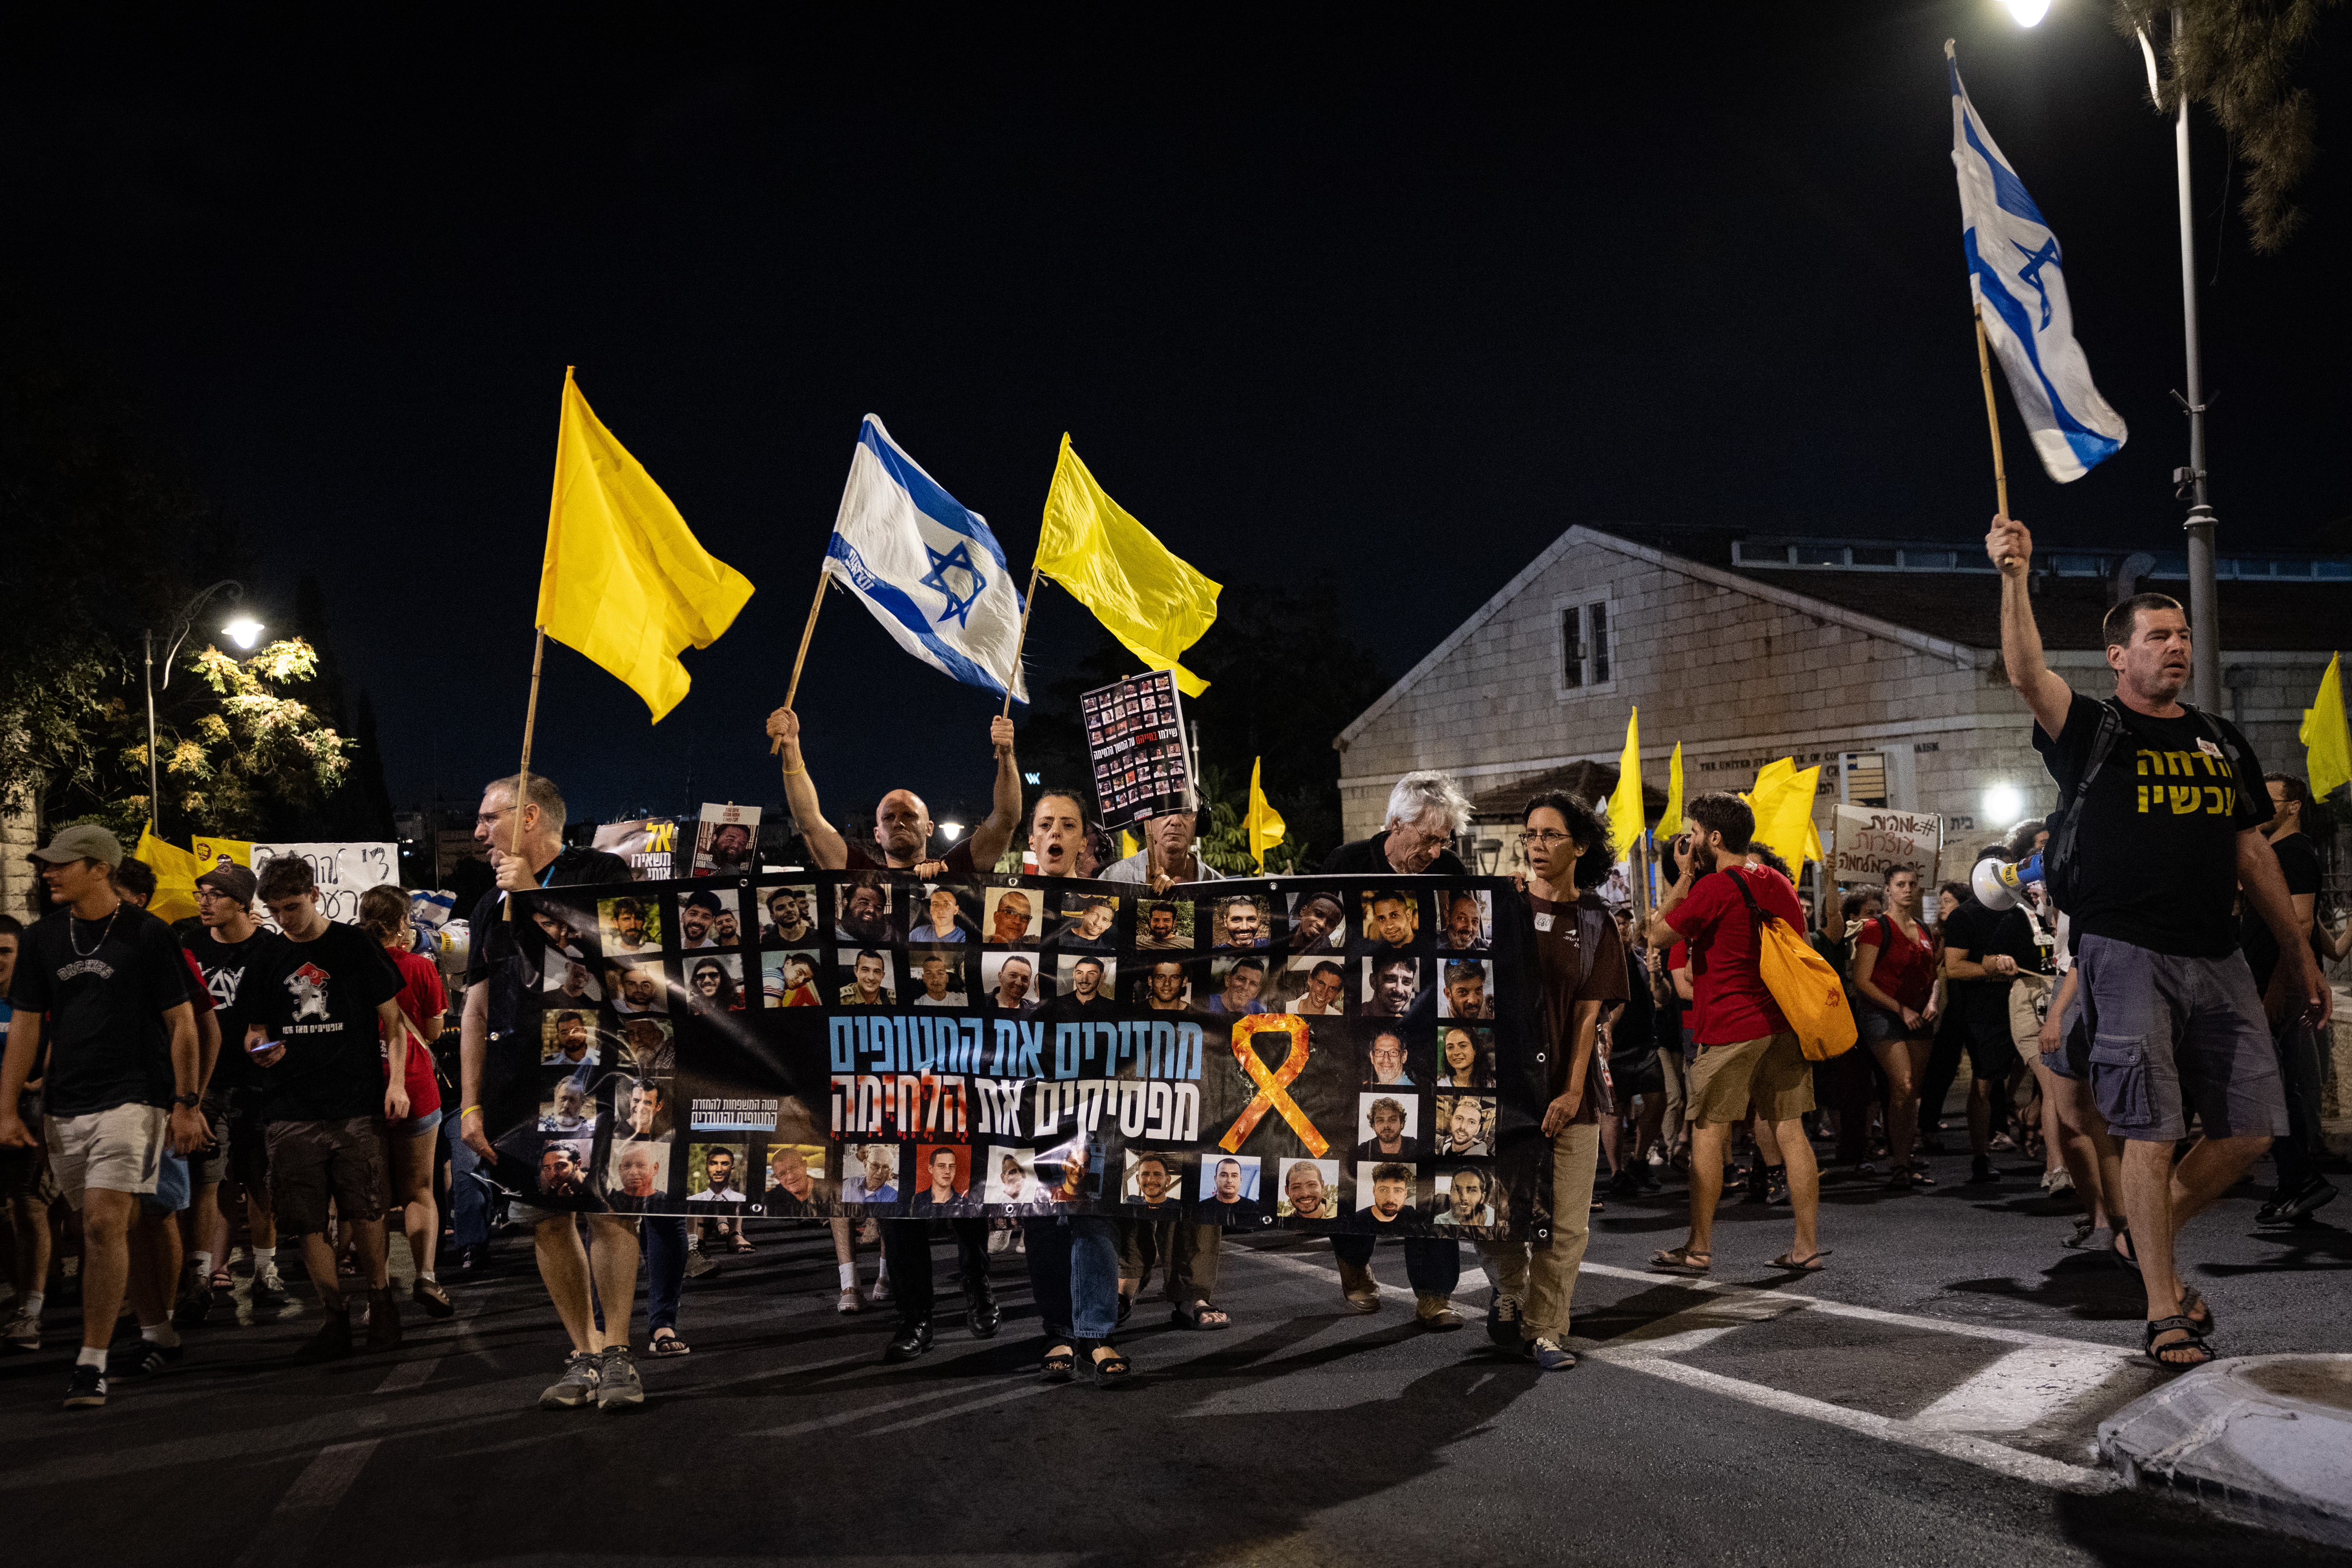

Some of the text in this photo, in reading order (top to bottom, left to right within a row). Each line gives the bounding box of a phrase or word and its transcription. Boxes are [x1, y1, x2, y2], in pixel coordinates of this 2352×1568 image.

[1093, 728, 1177, 760] שילמו בחייהם על המשך הלחימה
[1700, 762, 1716, 772] THE
[1720, 759, 1750, 770] UNITED
[2138, 785, 2235, 817] עכשיו
[1861, 815, 1936, 836] #אמהות
[1950, 816, 1974, 830] בית
[645, 822, 674, 852] אל
[1849, 832, 1914, 856] עוצרות
[631, 852, 671, 868] תשאירו
[697, 853, 713, 861] BRING
[647, 867, 670, 880] אותי
[57, 959, 115, 981] DICKIES
[296, 1025, 308, 1033] מאז
[310, 1022, 343, 1033] אופטימים
[829, 1016, 1202, 1080] מחזירים את החטופים
[692, 1098, 777, 1110] מטה המשפחות להחזרת
[831, 1068, 1199, 1142] מפסיקים את הלחימה
[691, 1111, 777, 1126] החטופים והנעדרים
